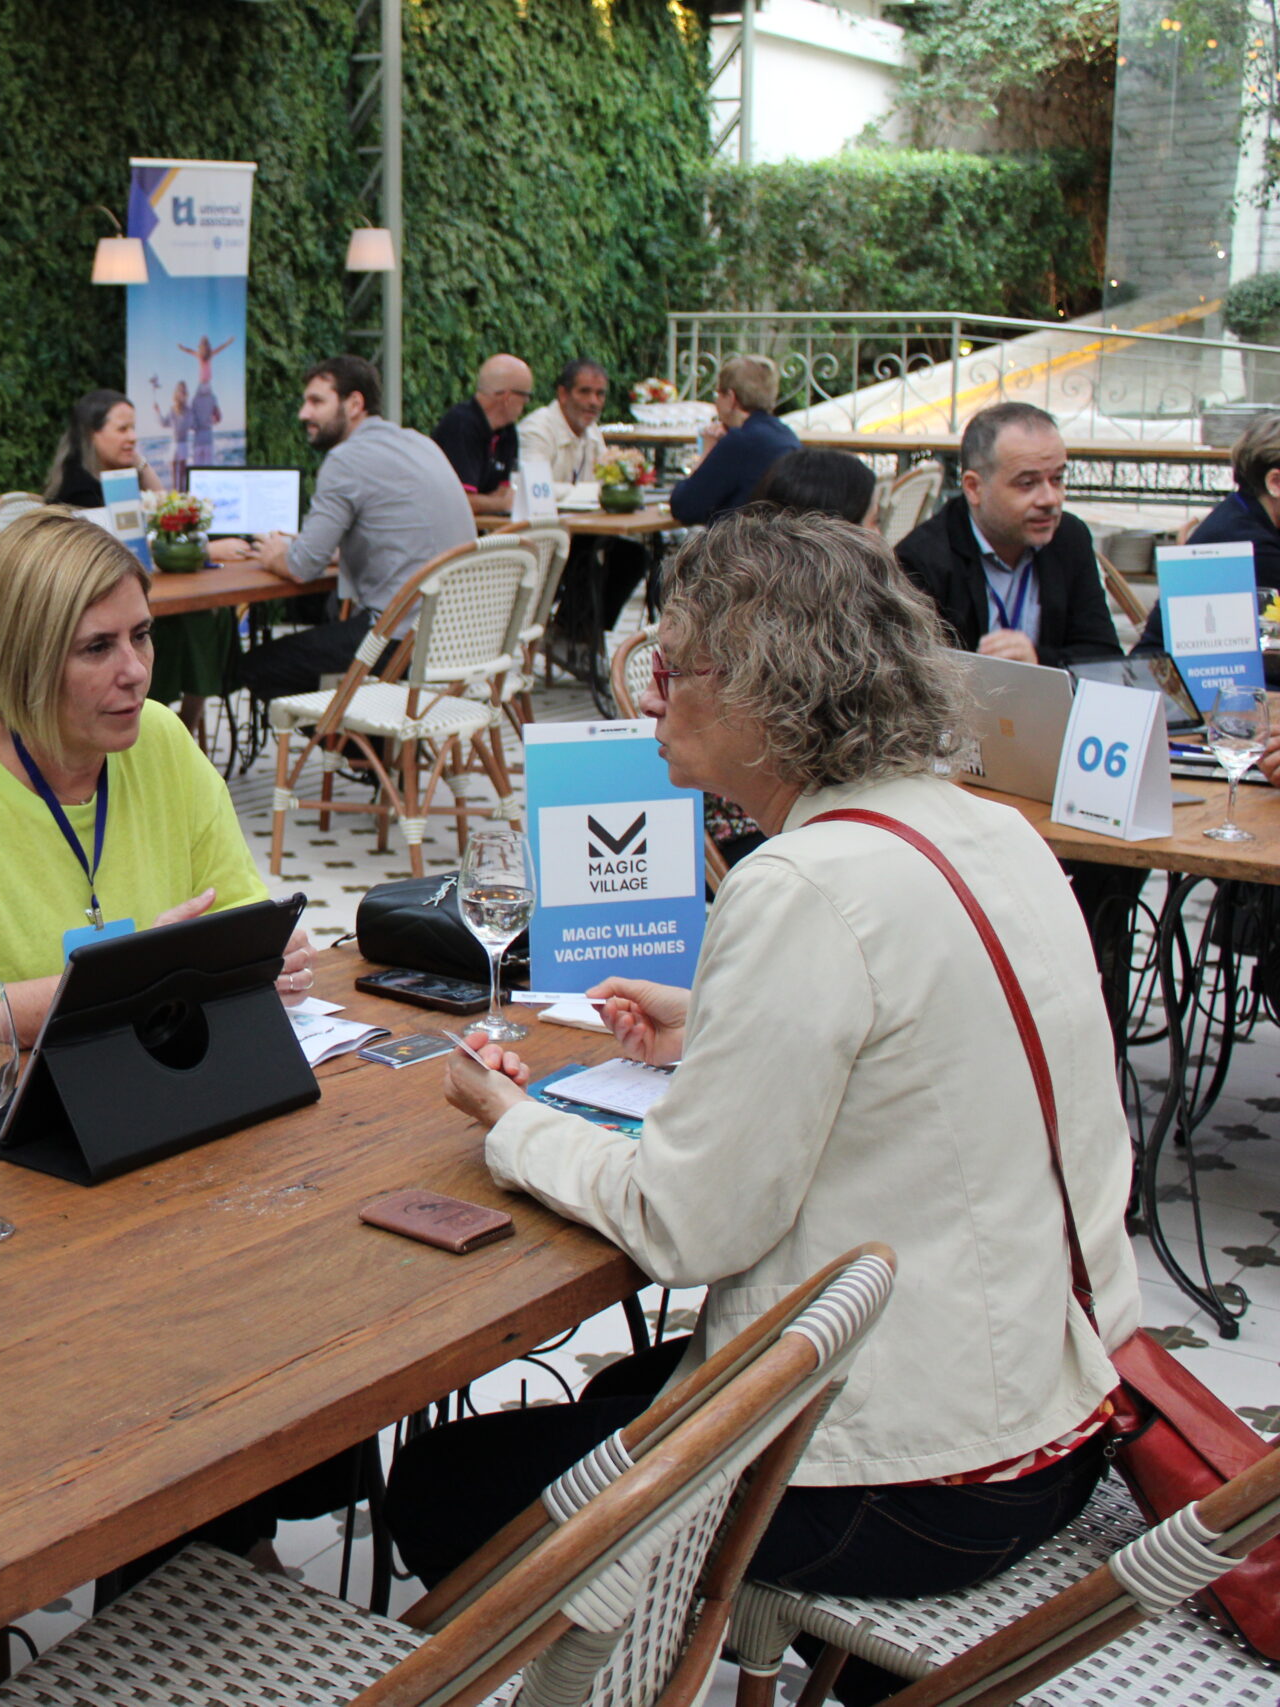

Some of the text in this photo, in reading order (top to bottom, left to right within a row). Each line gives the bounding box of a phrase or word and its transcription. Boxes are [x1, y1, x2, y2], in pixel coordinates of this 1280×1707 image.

[532, 483, 551, 498] 09
[1188, 664, 1246, 677] ROCKEFELLER
[1201, 677, 1235, 689] CENTER
[1077, 736, 1130, 778] 06
[589, 859, 647, 876] MAGIC
[590, 877, 648, 893] VILLAGE
[562, 920, 677, 942] MAGIC VILLAGE
[554, 939, 686, 963] VACATION HOMES
